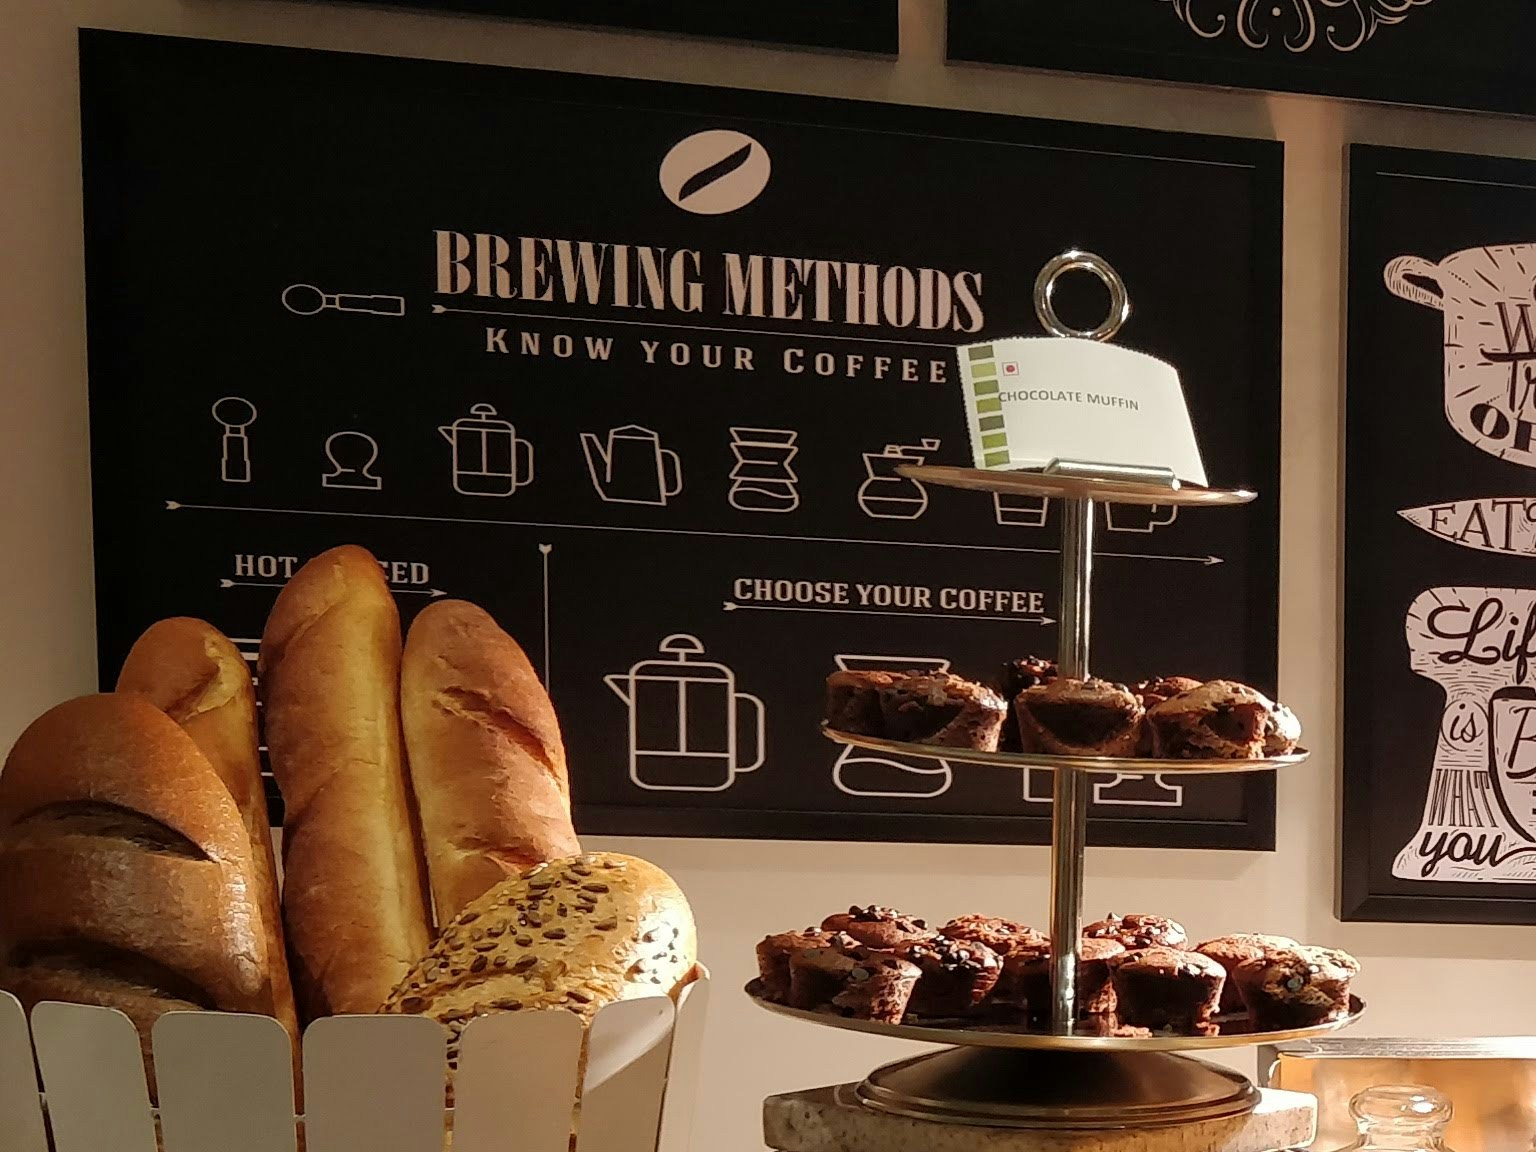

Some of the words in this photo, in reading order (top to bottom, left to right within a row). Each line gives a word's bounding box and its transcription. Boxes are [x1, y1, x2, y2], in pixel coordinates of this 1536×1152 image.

[434, 229, 702, 314] BREWING
[722, 251, 984, 333] METHODS
[485, 326, 613, 361] KNOW
[640, 339, 756, 373] YOUR
[782, 347, 948, 384] COFFEE
[997, 388, 1083, 406] CHOCOLATE
[1085, 392, 1140, 411] MUFFIN
[1427, 499, 1528, 554] EAT
[234, 553, 299, 579] HOT
[733, 577, 849, 605] CHOOSE
[856, 582, 932, 608] YOUR
[939, 587, 1045, 614] COFFEE
[1444, 701, 1481, 745] is
[1427, 768, 1498, 829] WHAT
[1418, 829, 1503, 877] you
